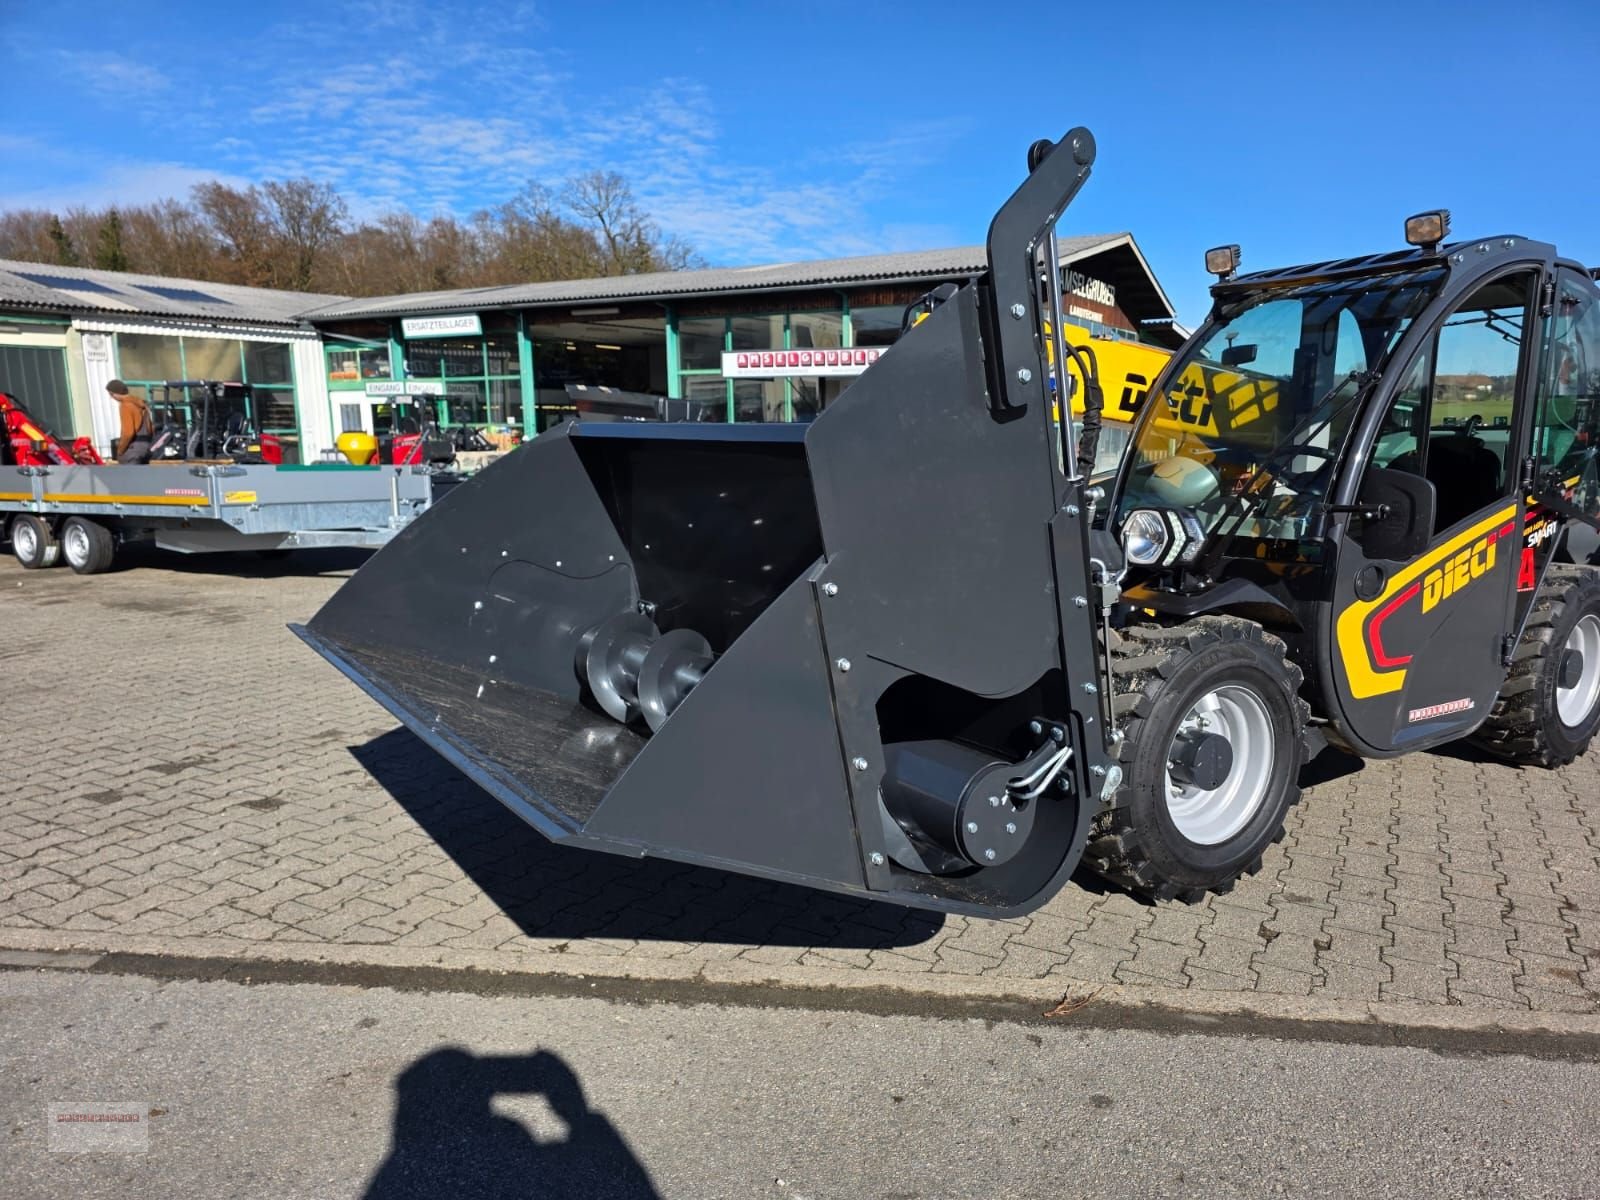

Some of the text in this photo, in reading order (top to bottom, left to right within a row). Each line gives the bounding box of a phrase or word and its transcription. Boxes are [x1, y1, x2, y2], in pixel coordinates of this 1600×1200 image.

[1061, 268, 1115, 307] AMSELGRUBER
[406, 319, 474, 331] ERSATZTEILLAGER
[737, 351, 880, 368] AMSELGRUBER
[369, 384, 400, 393] EINGANG
[1528, 521, 1557, 547] SMART
[1422, 532, 1497, 615] DIECI
